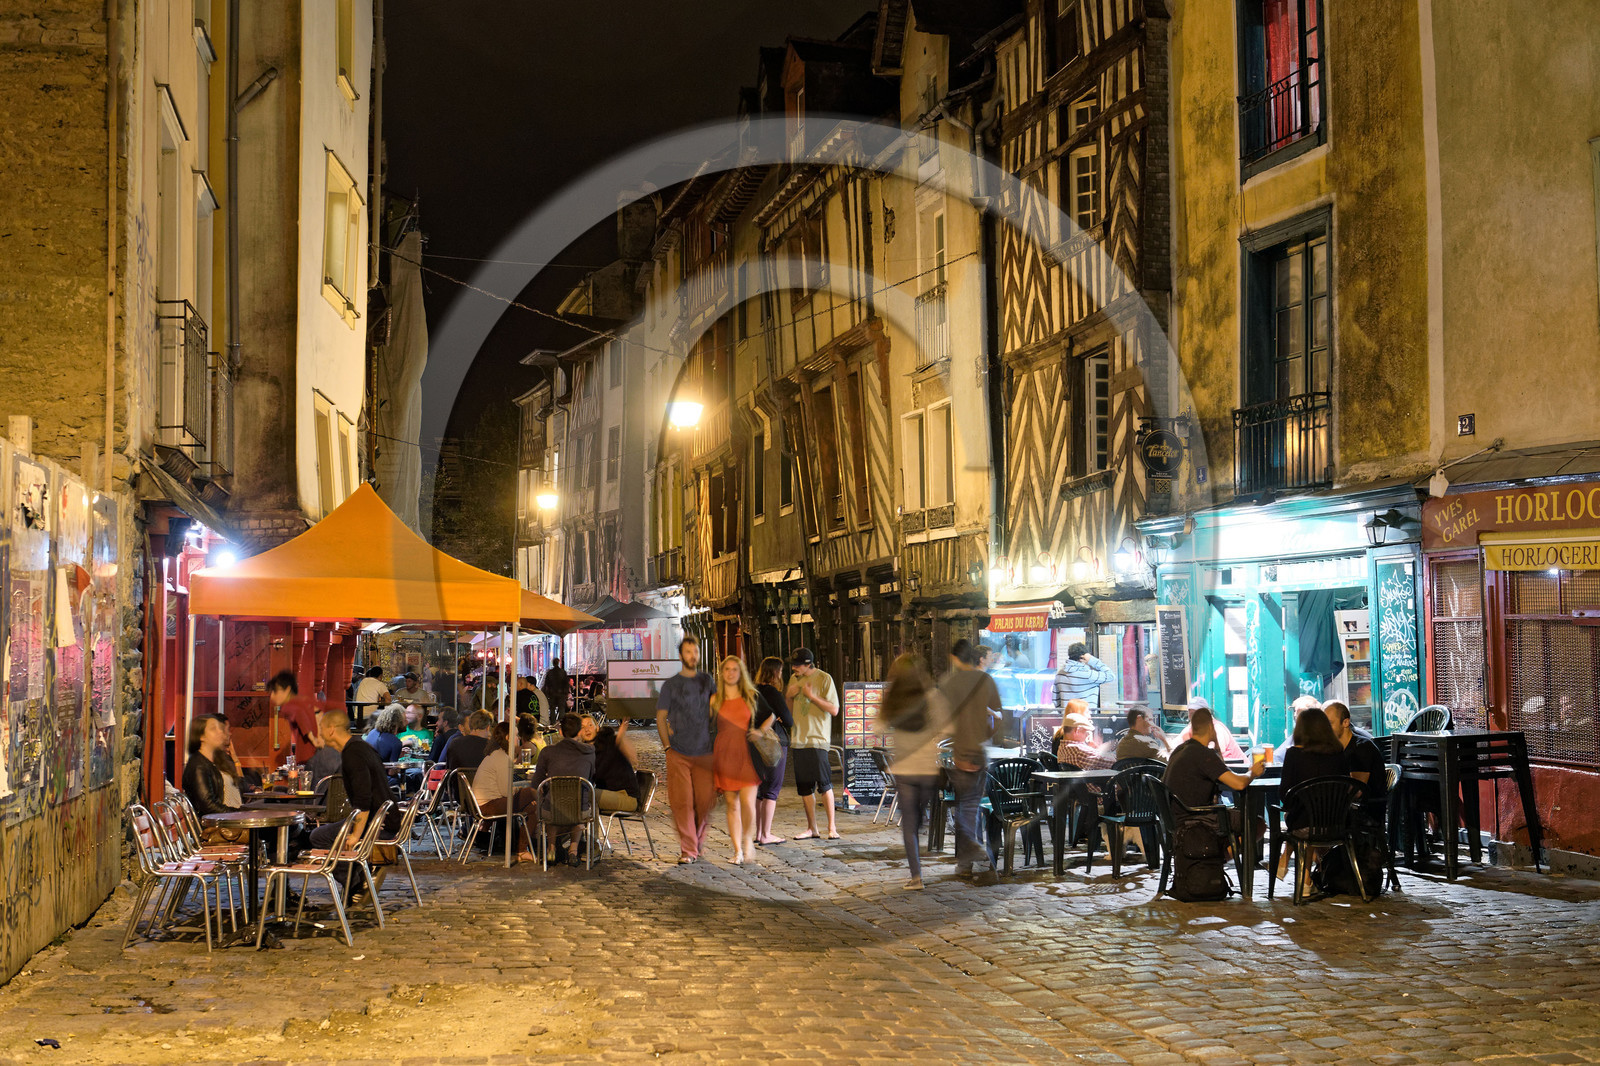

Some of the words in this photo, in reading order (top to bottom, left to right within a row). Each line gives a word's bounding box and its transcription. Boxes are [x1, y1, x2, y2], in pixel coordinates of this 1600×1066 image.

[1462, 417, 1470, 432] 2
[1434, 498, 1463, 528] YVES
[1442, 508, 1481, 543] GAREL
[994, 617, 1014, 630] PALAIS
[1015, 617, 1025, 629] DU
[1025, 615, 1045, 629] KEBAB
